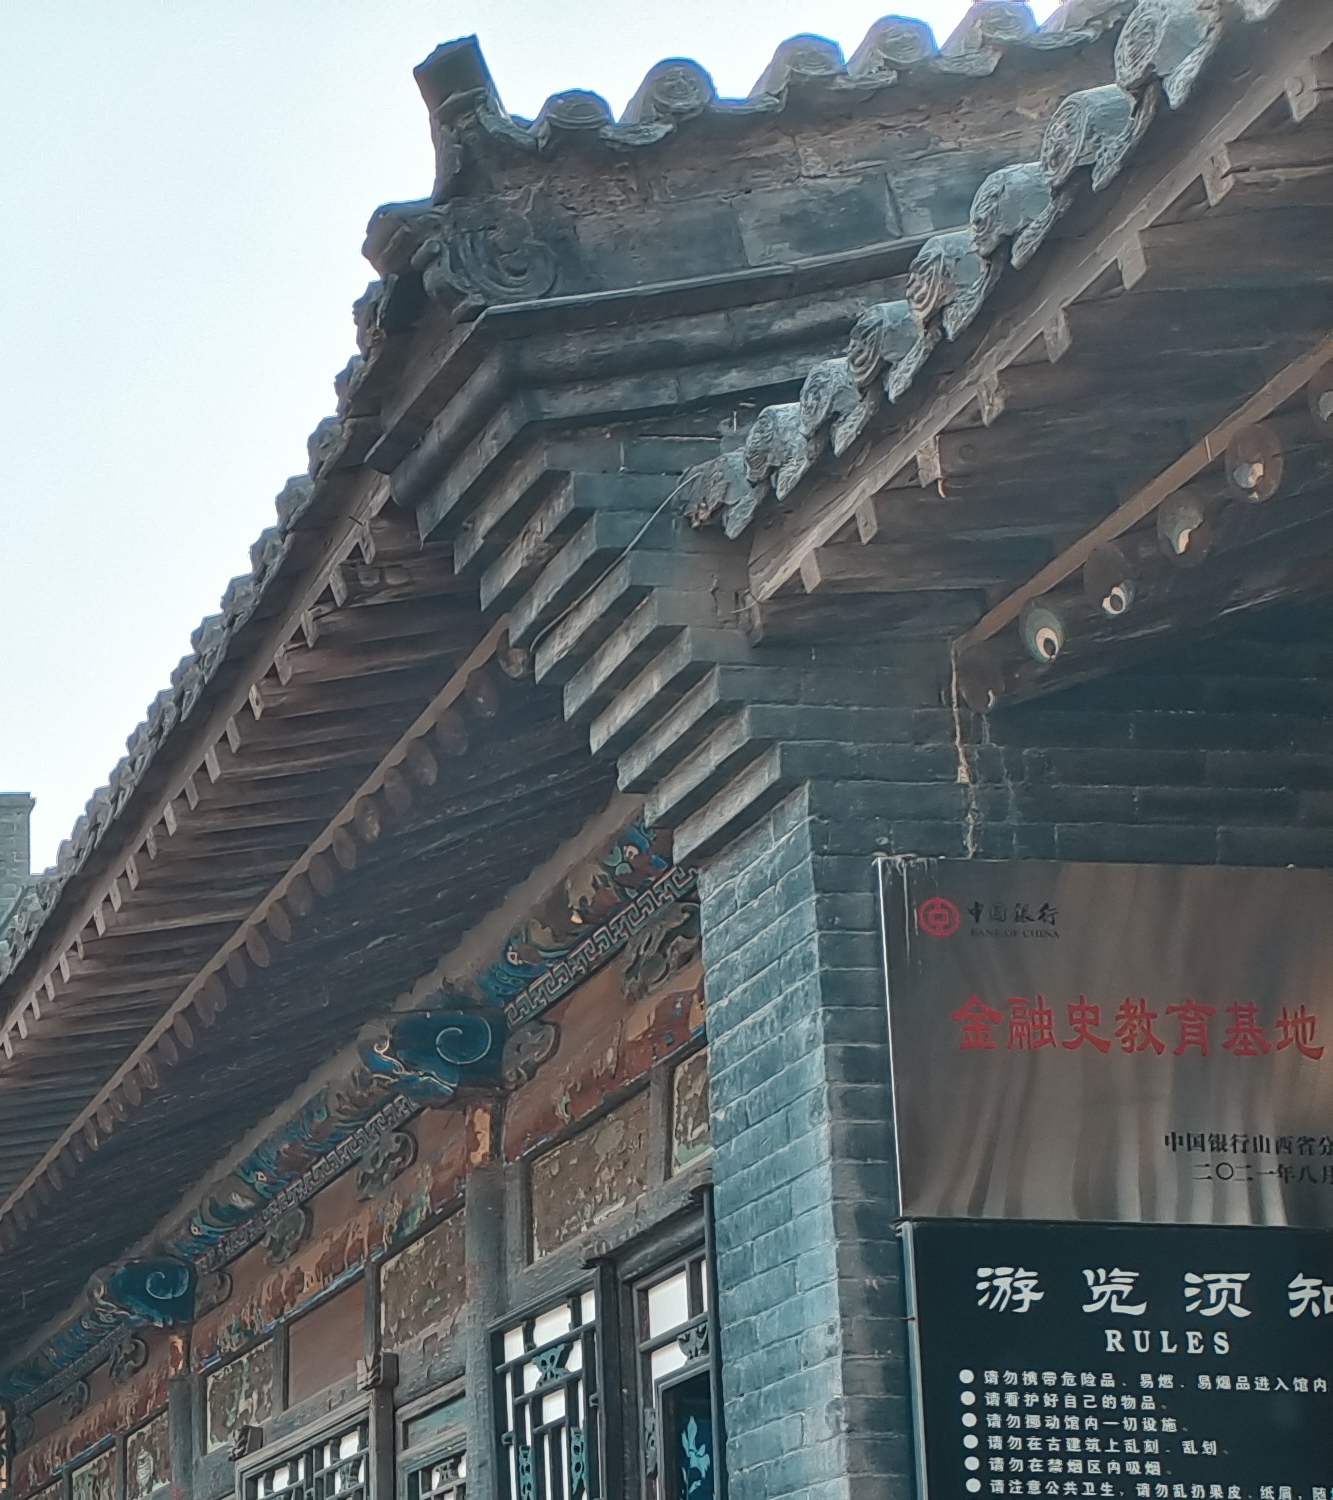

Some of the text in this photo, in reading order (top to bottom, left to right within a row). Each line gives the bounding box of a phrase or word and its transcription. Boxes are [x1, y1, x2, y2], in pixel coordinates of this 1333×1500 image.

[967, 900, 1060, 926] 中国银行
[951, 994, 1325, 1060] 金融史教育基地
[1164, 1131, 1333, 1156] 中国银行山西省分
[1105, 1330, 1229, 1354] RULES
